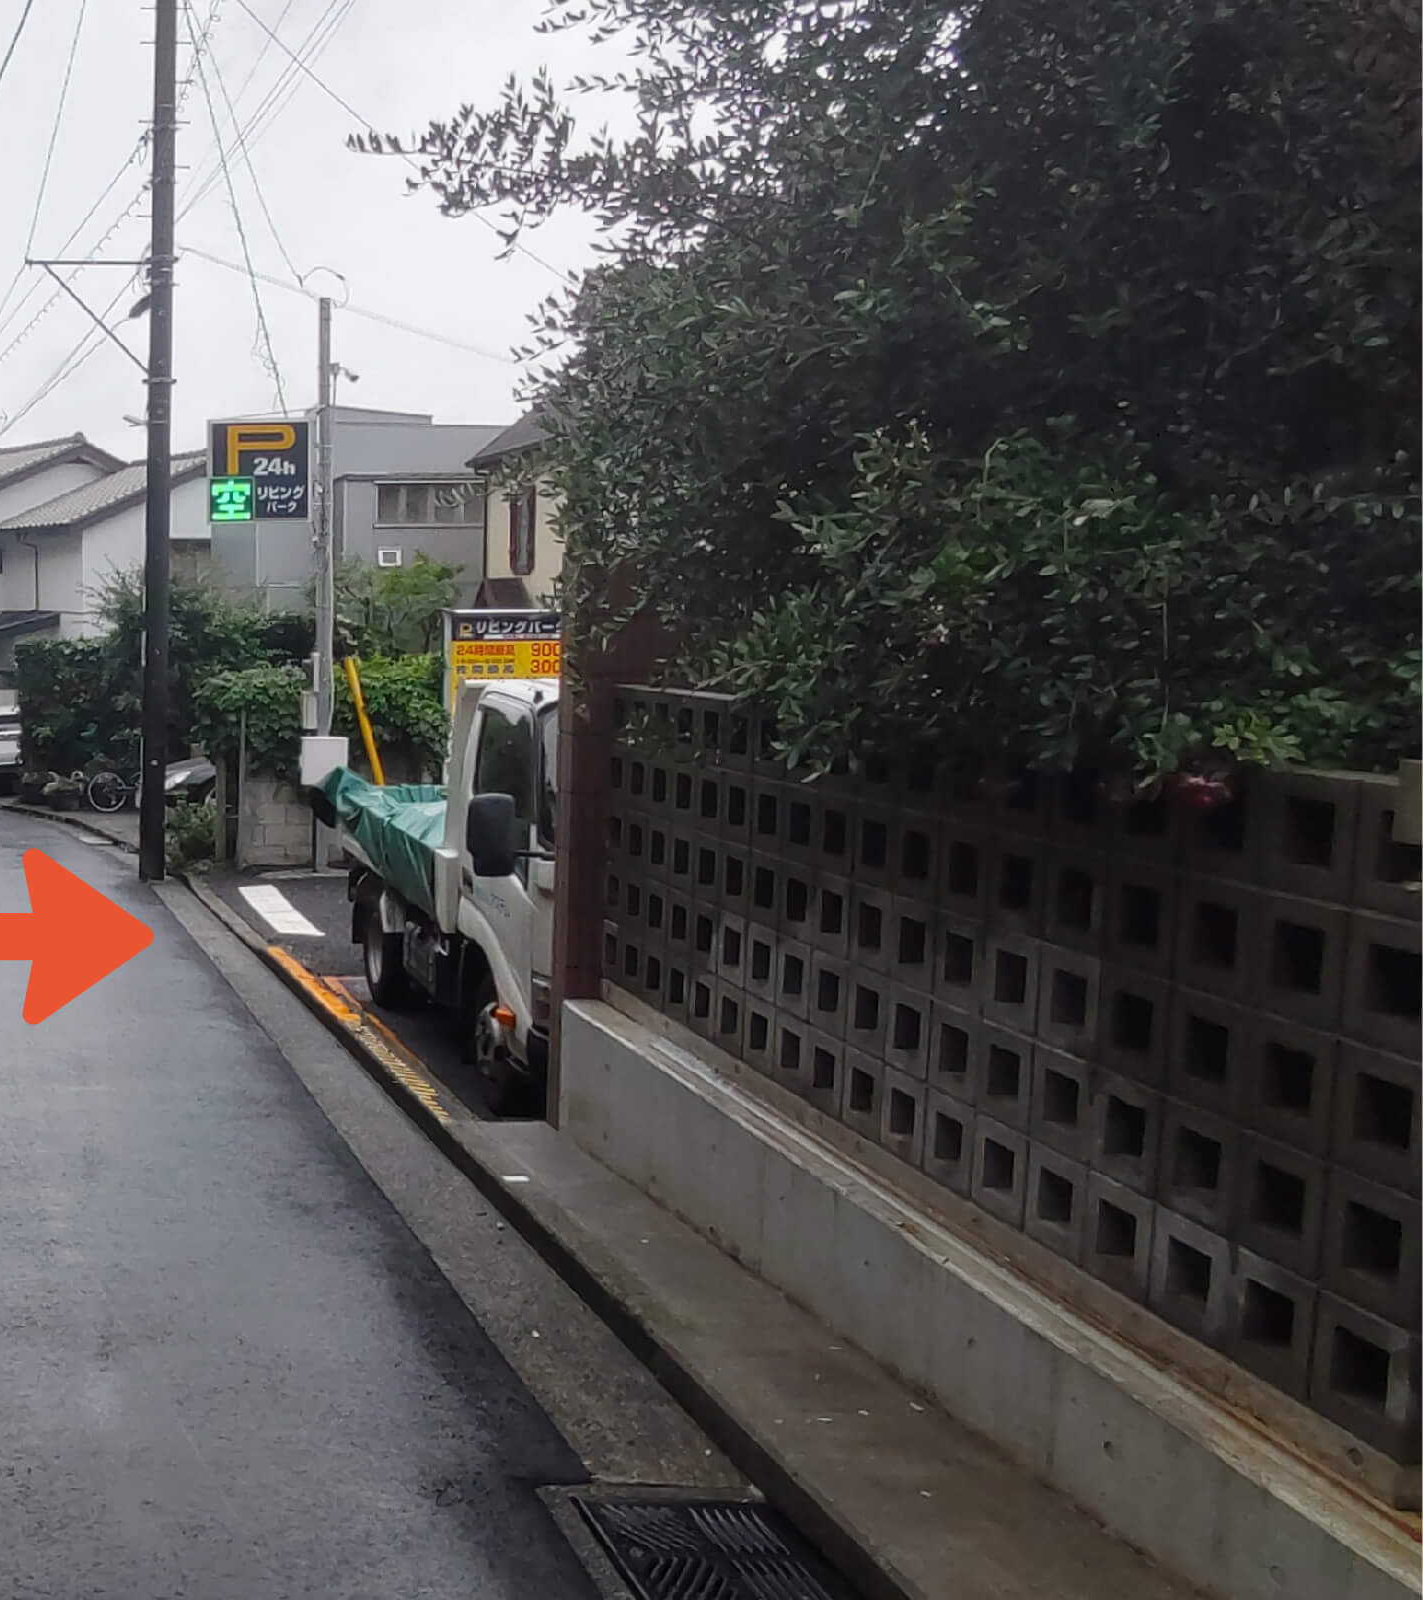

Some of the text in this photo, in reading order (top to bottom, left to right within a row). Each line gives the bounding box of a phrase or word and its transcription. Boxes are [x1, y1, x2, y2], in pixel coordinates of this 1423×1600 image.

[227, 424, 296, 476] P
[253, 457, 296, 476] 24h
[211, 480, 251, 520] 空
[257, 485, 305, 500] リビング
[267, 501, 297, 513] パーク
